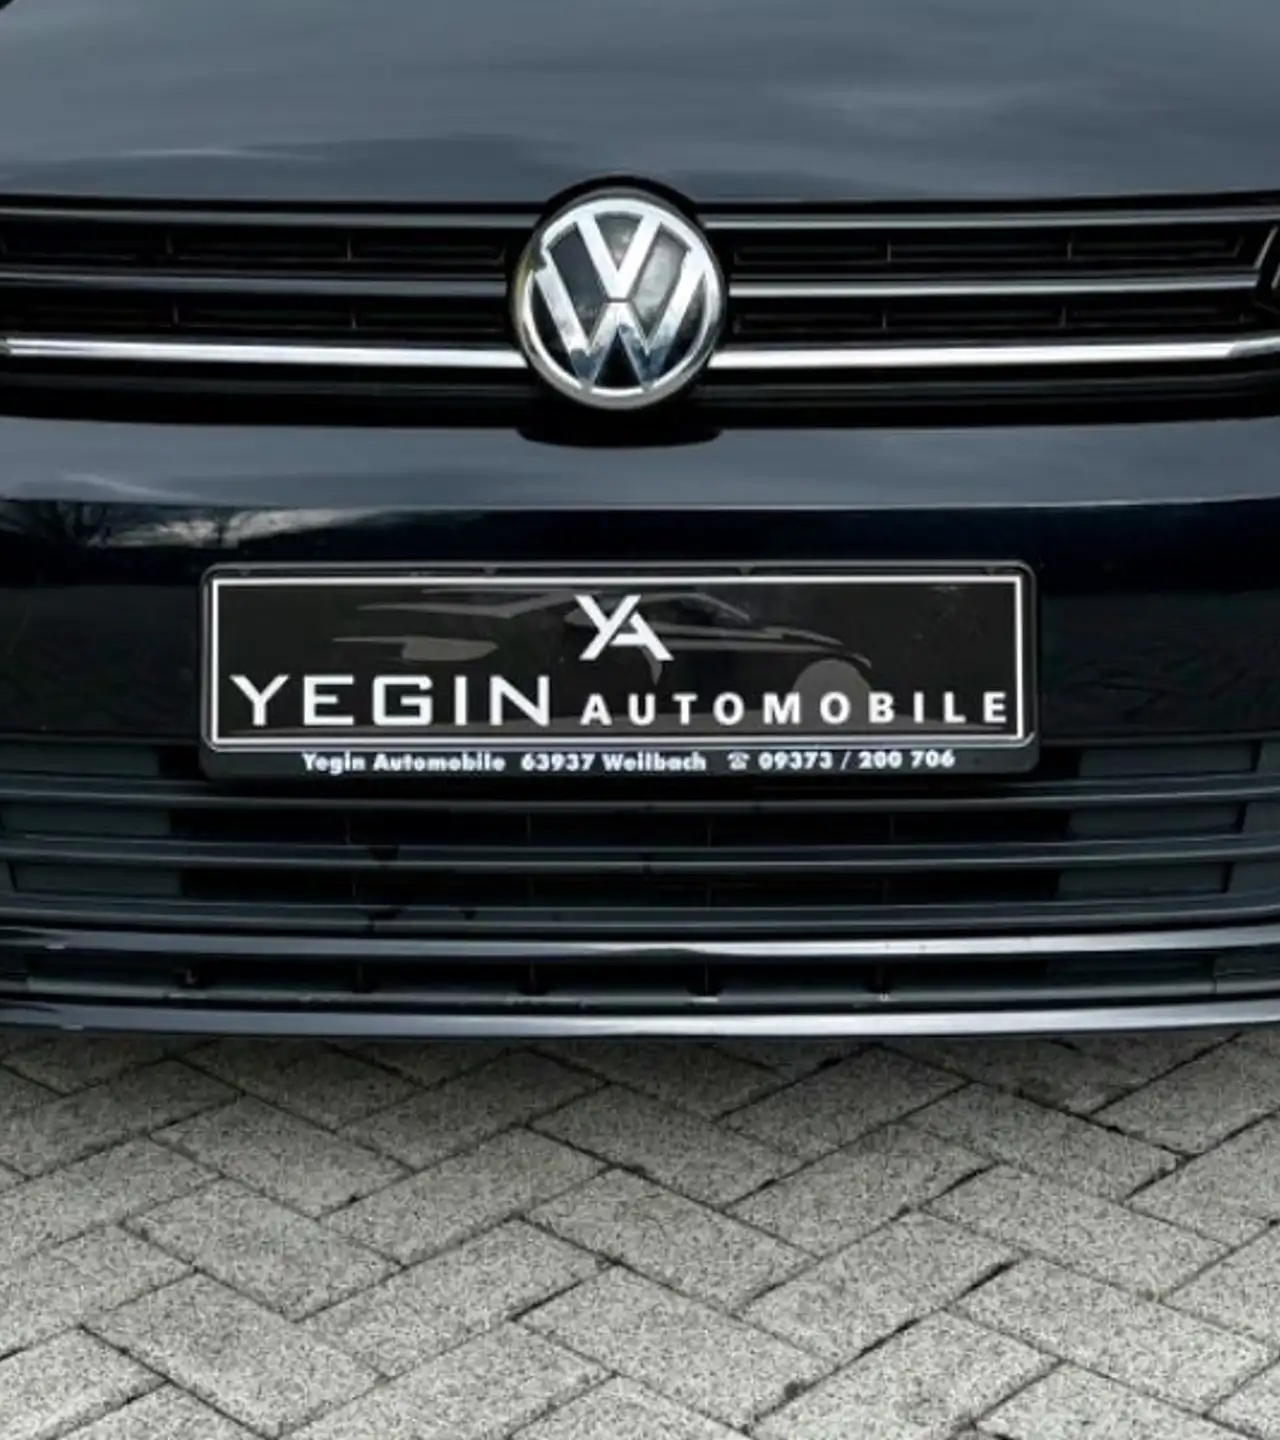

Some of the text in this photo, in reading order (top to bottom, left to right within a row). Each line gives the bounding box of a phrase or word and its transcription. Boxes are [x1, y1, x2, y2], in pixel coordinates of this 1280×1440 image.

[524, 198, 717, 396] VW
[228, 673, 1009, 728] YEGIN AUTOMOBILE
[302, 750, 365, 776] Yegin
[372, 750, 506, 772] Automobile
[521, 752, 595, 772] 63937
[601, 749, 707, 772] Weilbach
[757, 750, 833, 771] 09373
[858, 750, 903, 770] 200
[911, 748, 956, 768] 706
